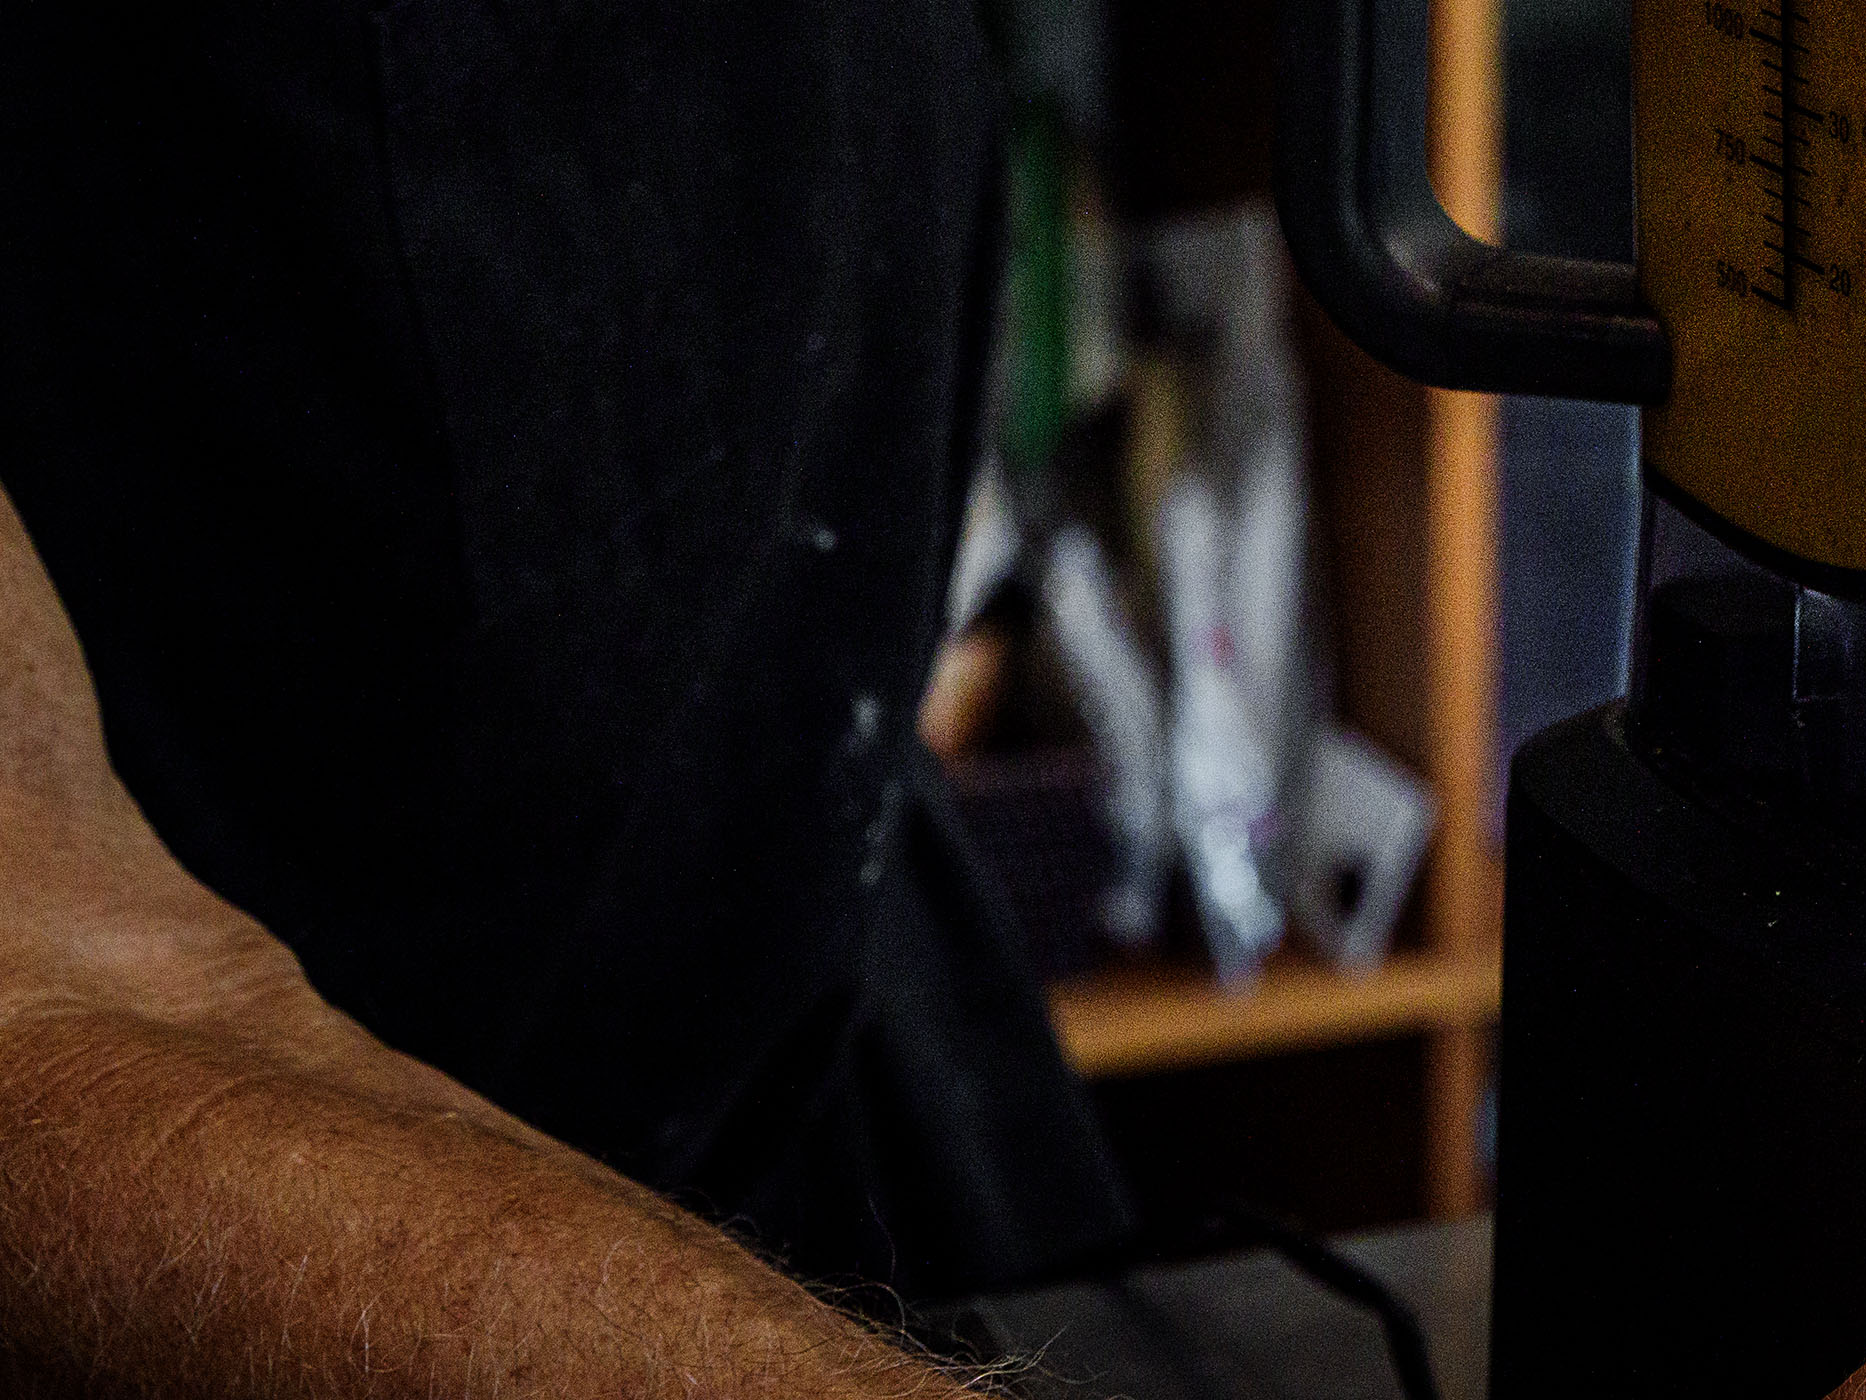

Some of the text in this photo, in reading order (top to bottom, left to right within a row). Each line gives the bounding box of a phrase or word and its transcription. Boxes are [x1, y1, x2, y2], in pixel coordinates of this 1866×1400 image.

[1704, 1, 1744, 40] 1000
[1828, 111, 1850, 143] 30
[1715, 128, 1746, 165] 750
[1830, 264, 1851, 297] 20
